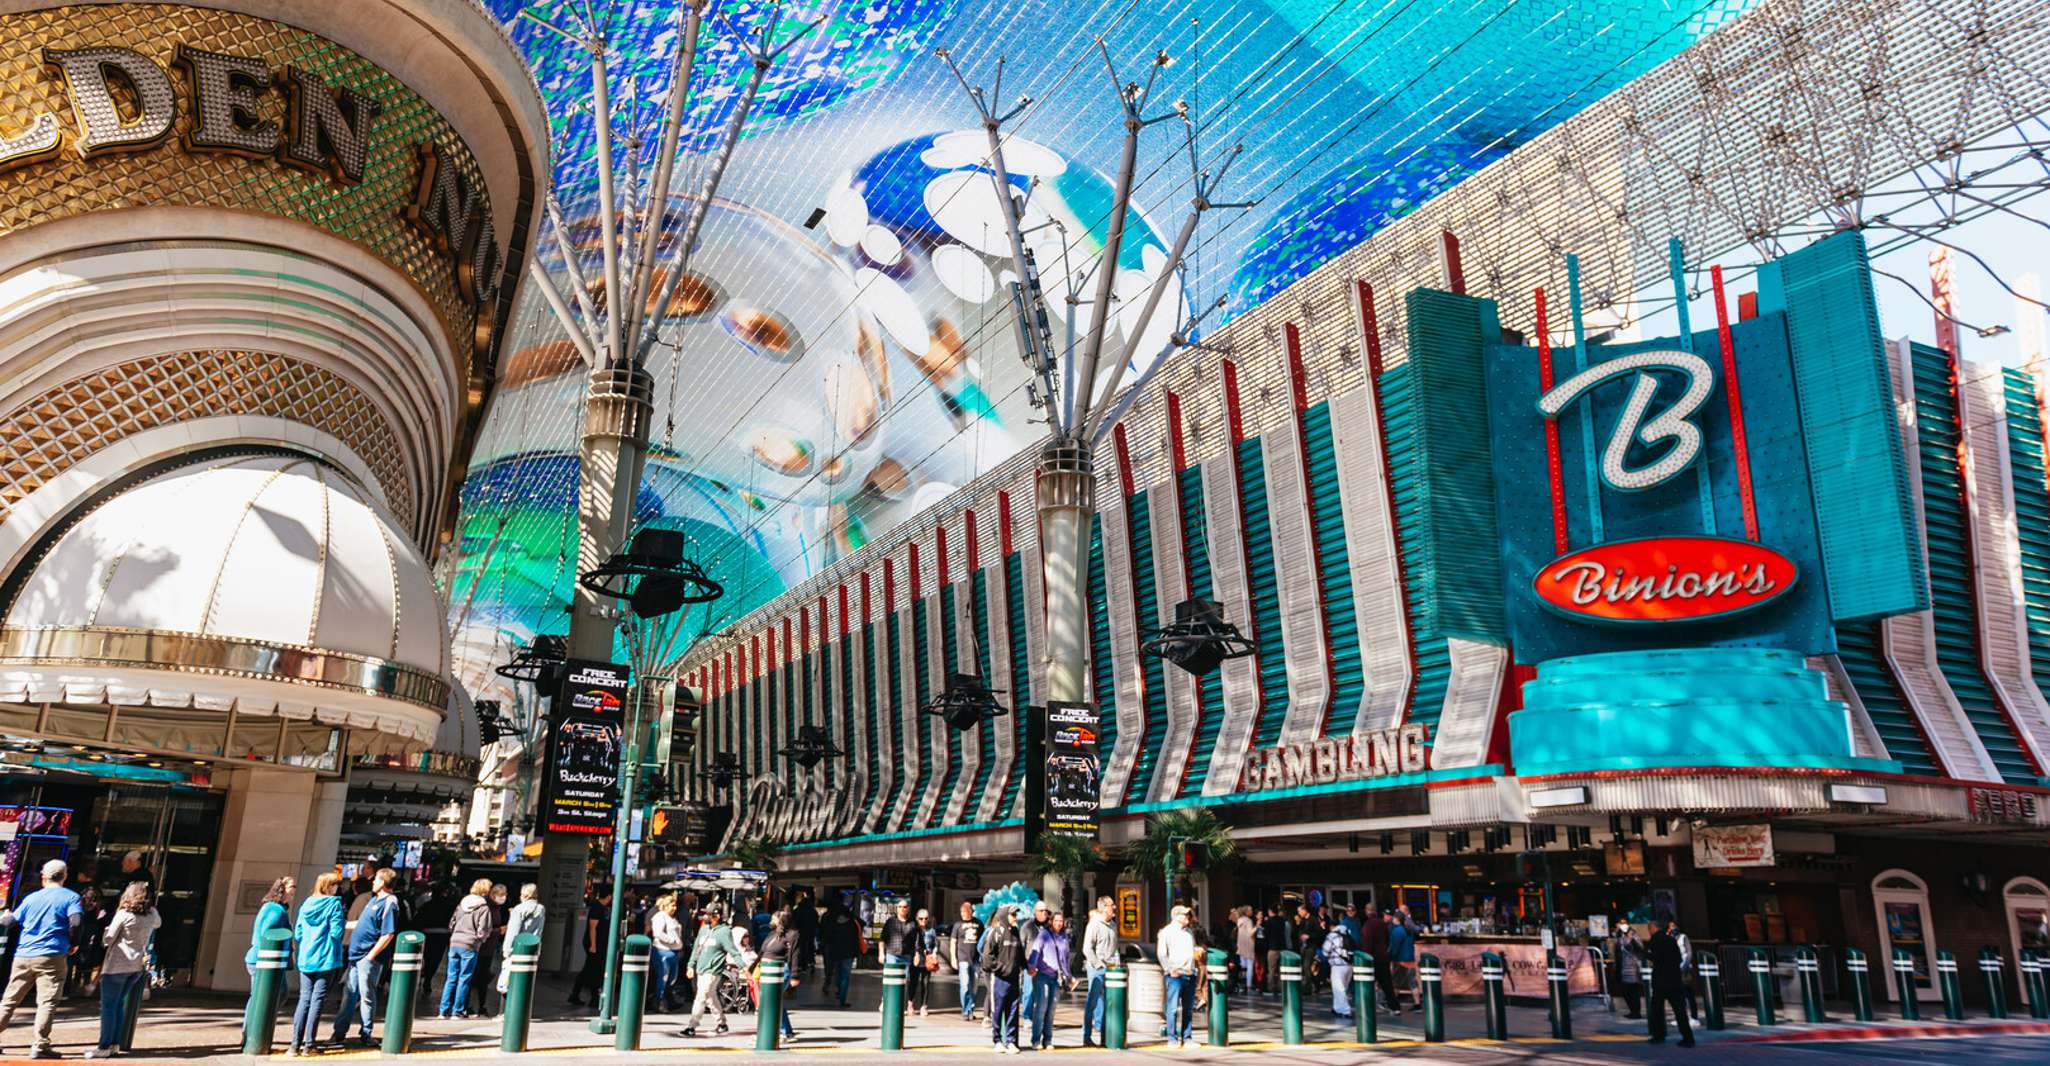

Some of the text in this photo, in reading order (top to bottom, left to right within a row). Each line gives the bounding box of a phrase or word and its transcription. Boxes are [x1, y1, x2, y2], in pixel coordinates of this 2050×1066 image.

[1537, 350, 1713, 490] B
[1553, 560, 1776, 606] Binion's
[583, 668, 616, 679] FREE
[569, 674, 627, 688] CONCERT
[1060, 708, 1090, 717] FREE
[1050, 714, 1099, 724] CONCERT
[1244, 722, 1427, 793] GAMBLING
[560, 769, 616, 788] Buckcherry
[565, 790, 605, 798] SATURDAY
[555, 798, 581, 806] MARCH
